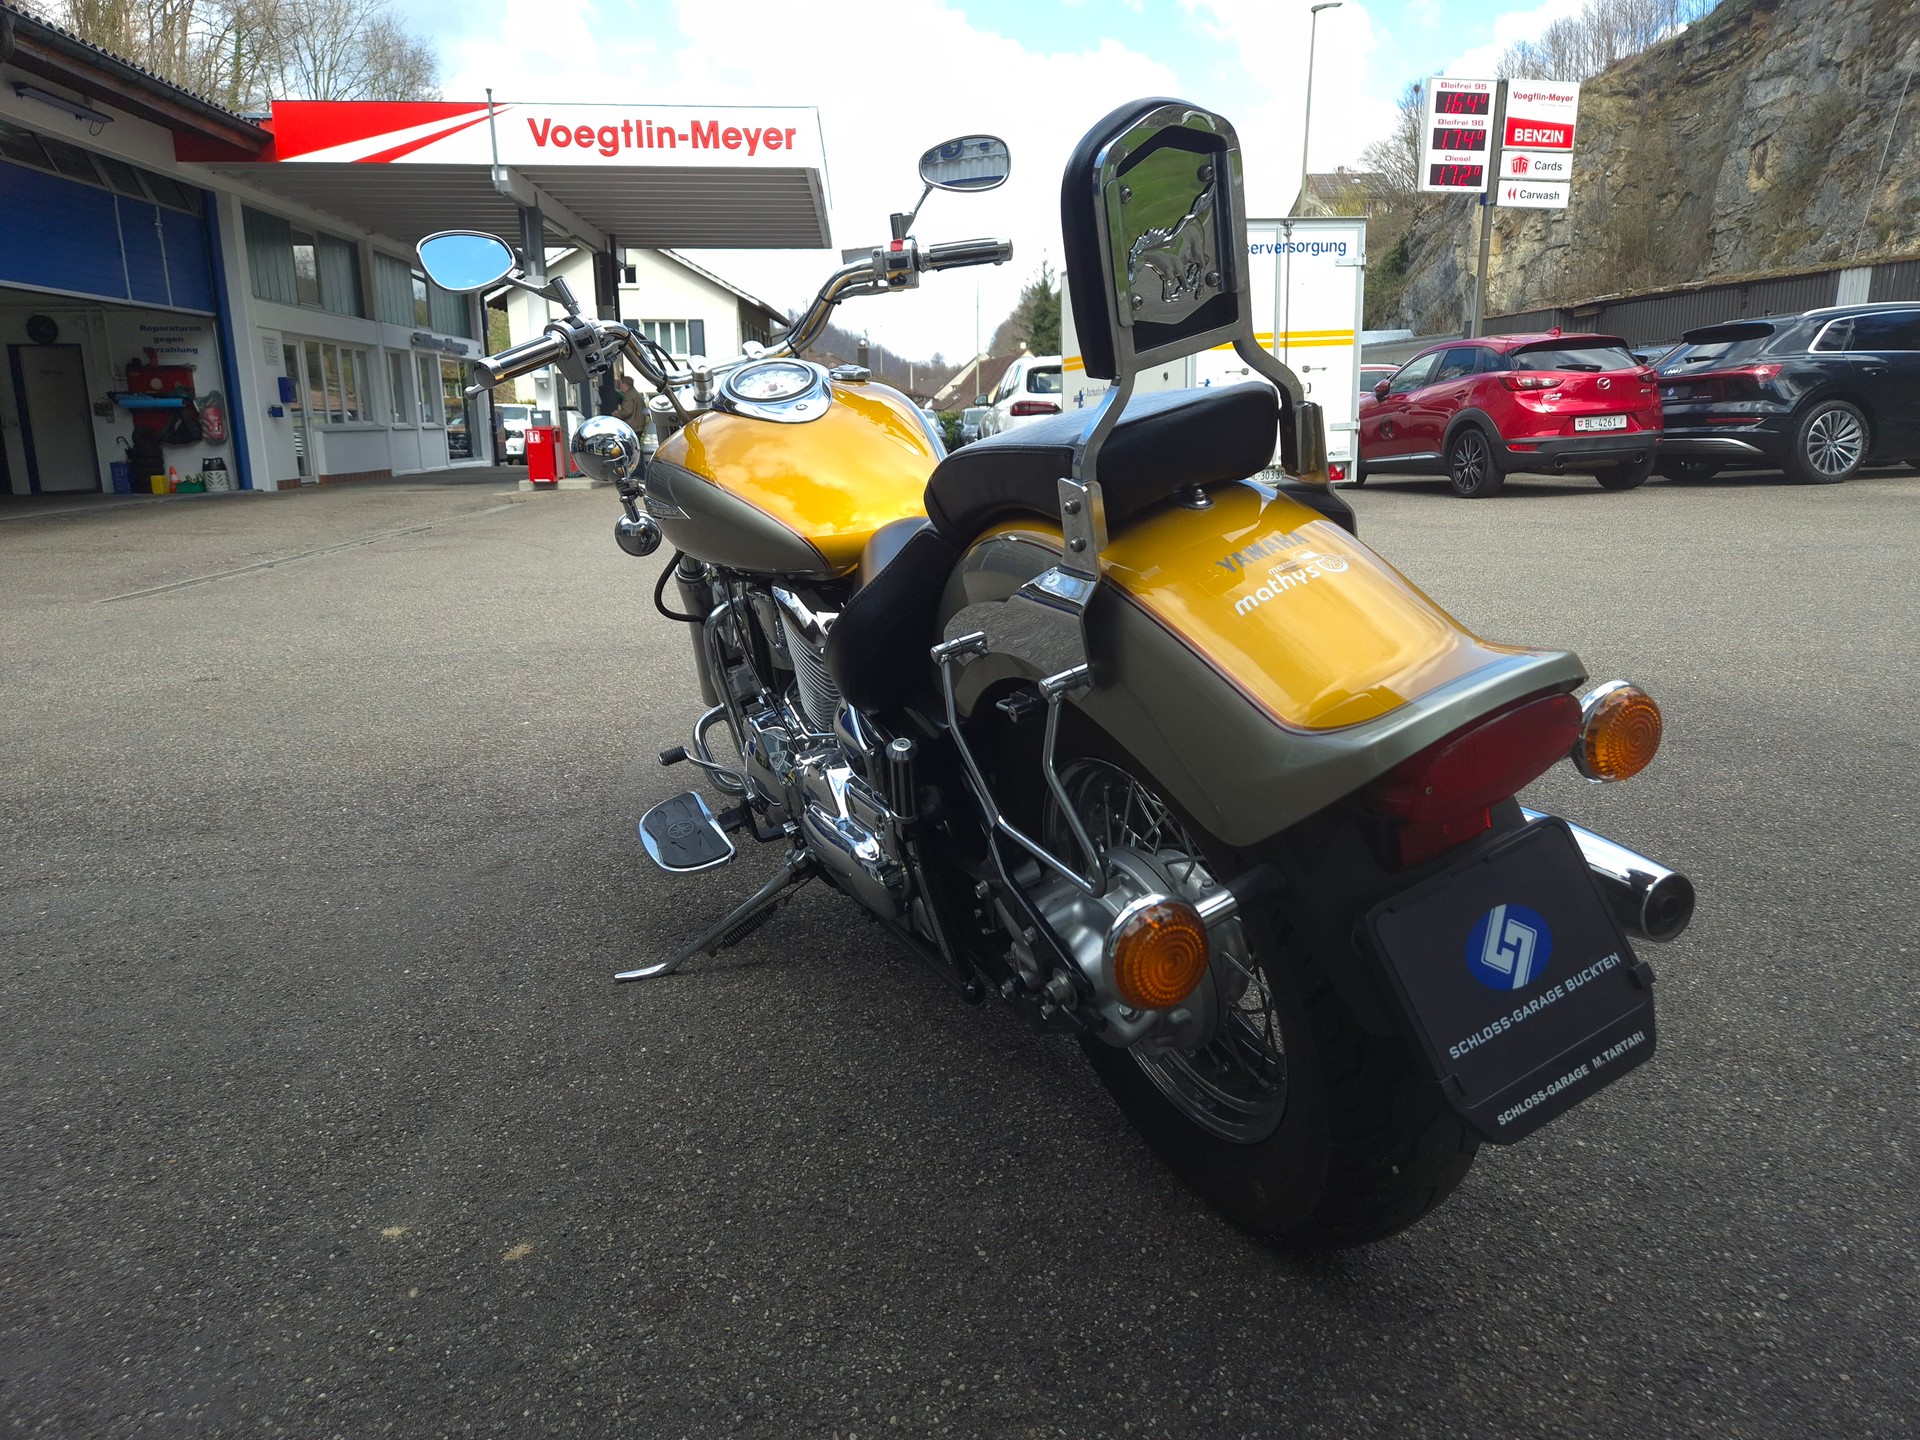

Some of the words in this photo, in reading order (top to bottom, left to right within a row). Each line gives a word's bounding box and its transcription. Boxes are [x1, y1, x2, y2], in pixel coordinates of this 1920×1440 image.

[1440, 82, 1471, 90] Bleifrei
[1513, 91, 1574, 103] Voegtlin-Meyer
[527, 118, 796, 157] Voegtlin-Meyer
[1514, 128, 1564, 143] BENZIN
[1534, 161, 1563, 171] Cards
[1519, 190, 1560, 200] Carwash
[1216, 531, 1311, 573] YAMAHA
[1234, 562, 1321, 616] mathys
[1448, 985, 1565, 1060] SCHLOSS-GARAGE
[1564, 952, 1621, 992] BUCKTEN
[1497, 1063, 1590, 1126] SCHLOSS-GARAGE
